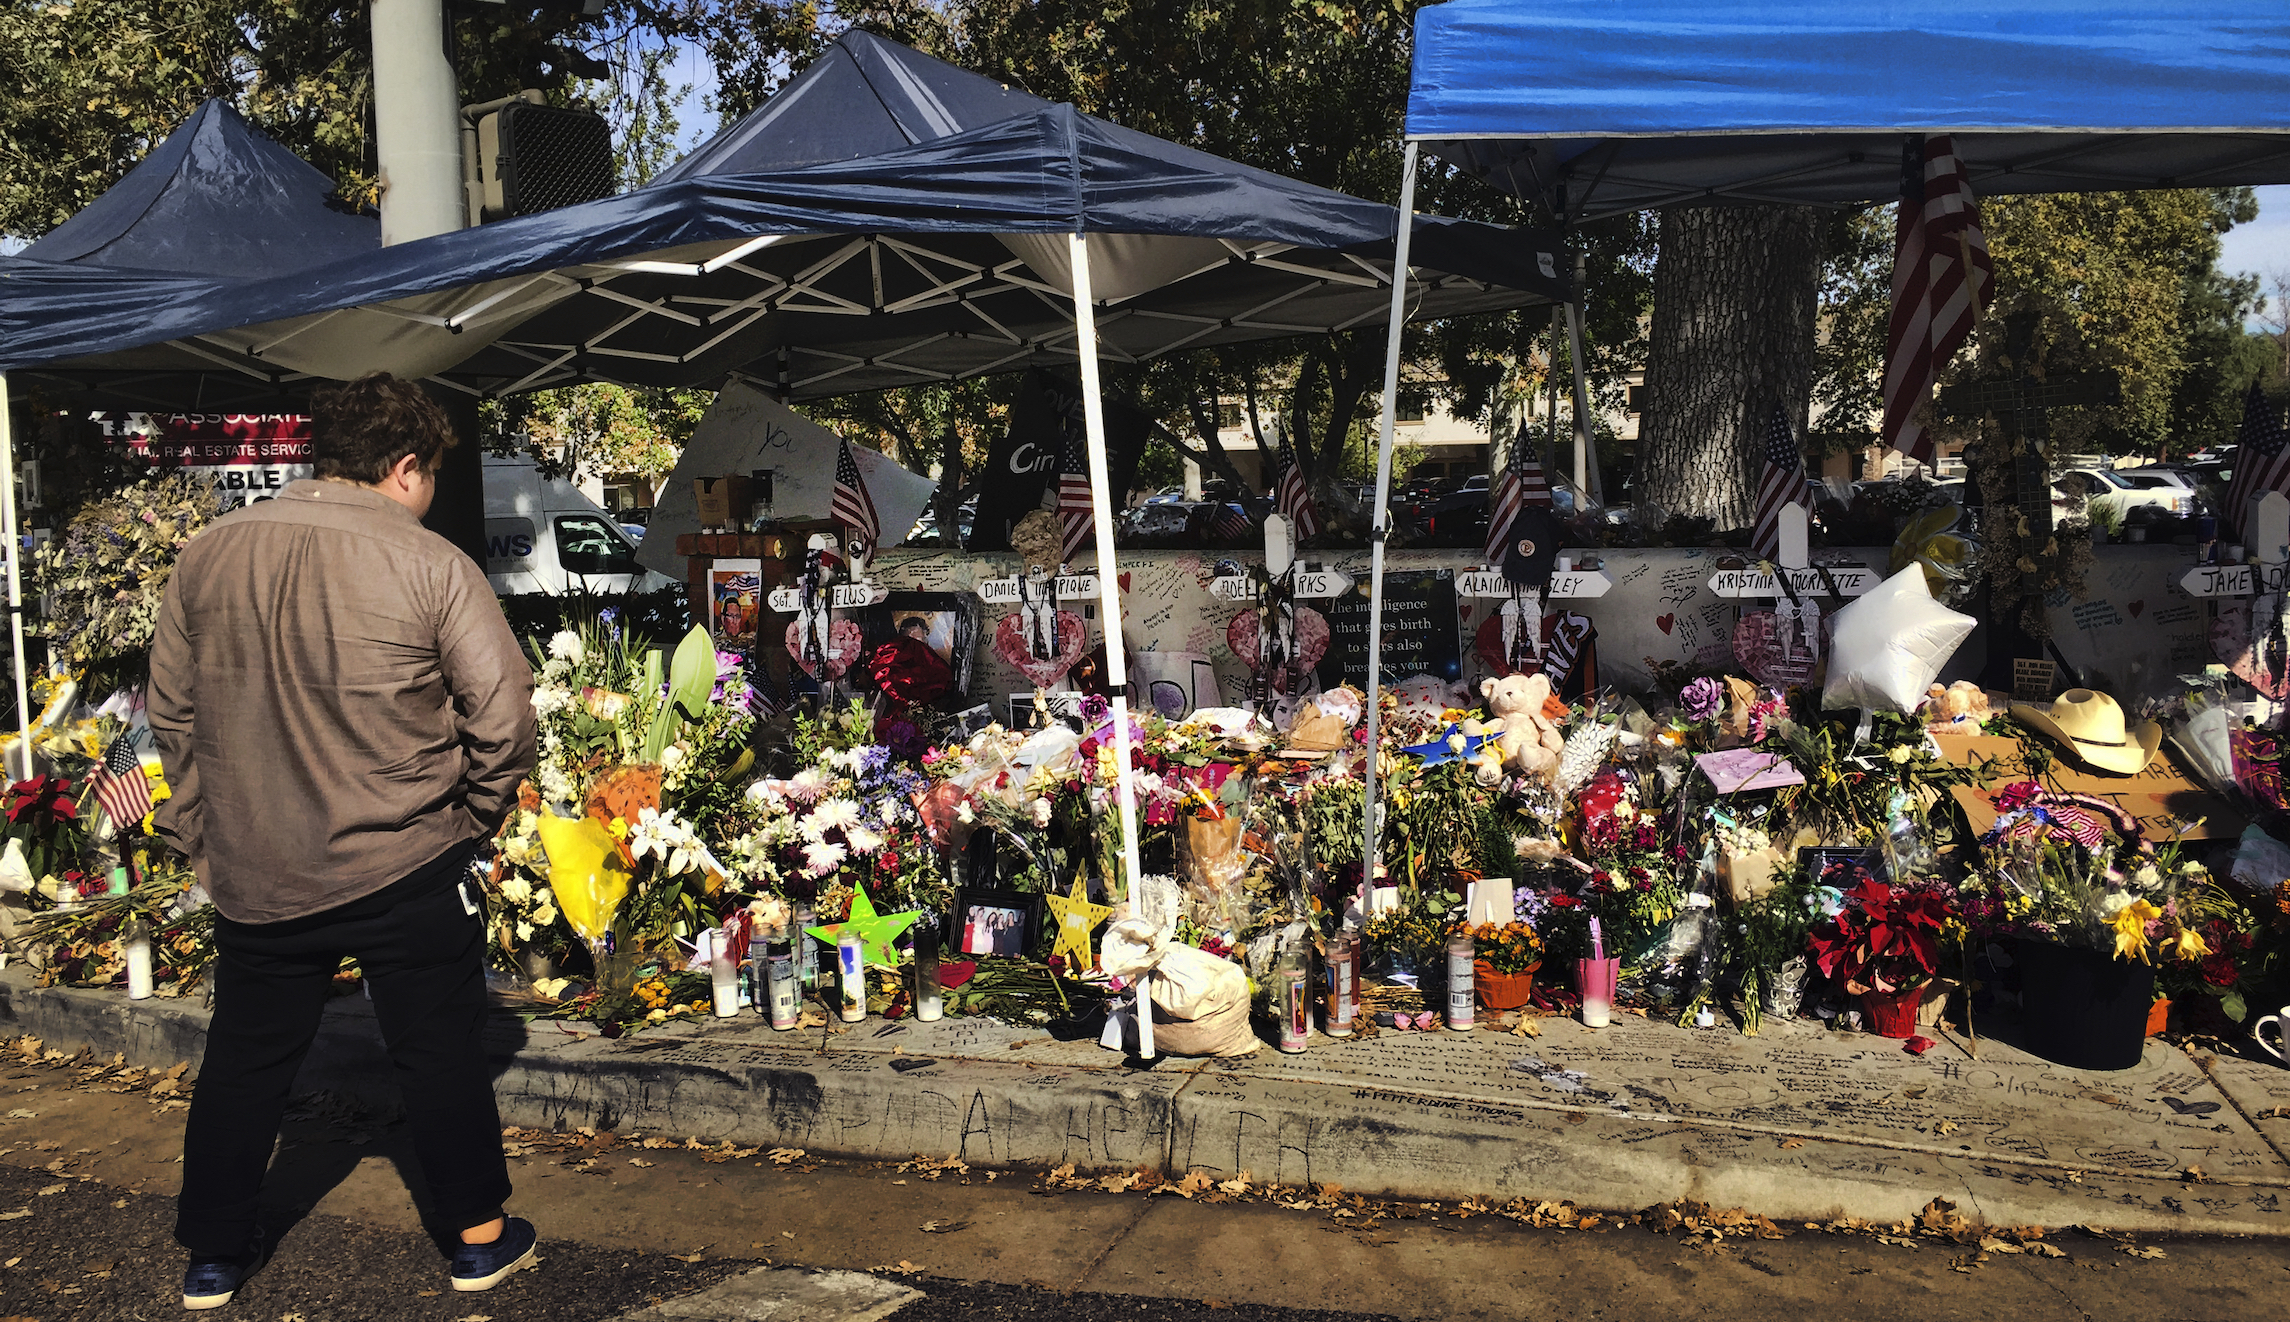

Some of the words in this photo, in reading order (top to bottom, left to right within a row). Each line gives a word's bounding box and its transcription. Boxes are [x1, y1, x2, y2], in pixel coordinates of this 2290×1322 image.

[164, 446, 200, 458] REAL
[205, 443, 256, 457] ESTATE
[260, 443, 314, 457] SERVIC
[1717, 573, 1775, 591] KRISTINA
[2201, 569, 2250, 593] JAKE
[984, 583, 1019, 599] DANIE
[1325, 597, 1352, 614] The
[1336, 621, 1362, 634] that
[1400, 617, 1432, 631] birth
[1348, 642, 1360, 653] to
[1396, 638, 1423, 651] also
[1400, 660, 1430, 673] your
[1465, 1102, 1526, 1121] STRONG
